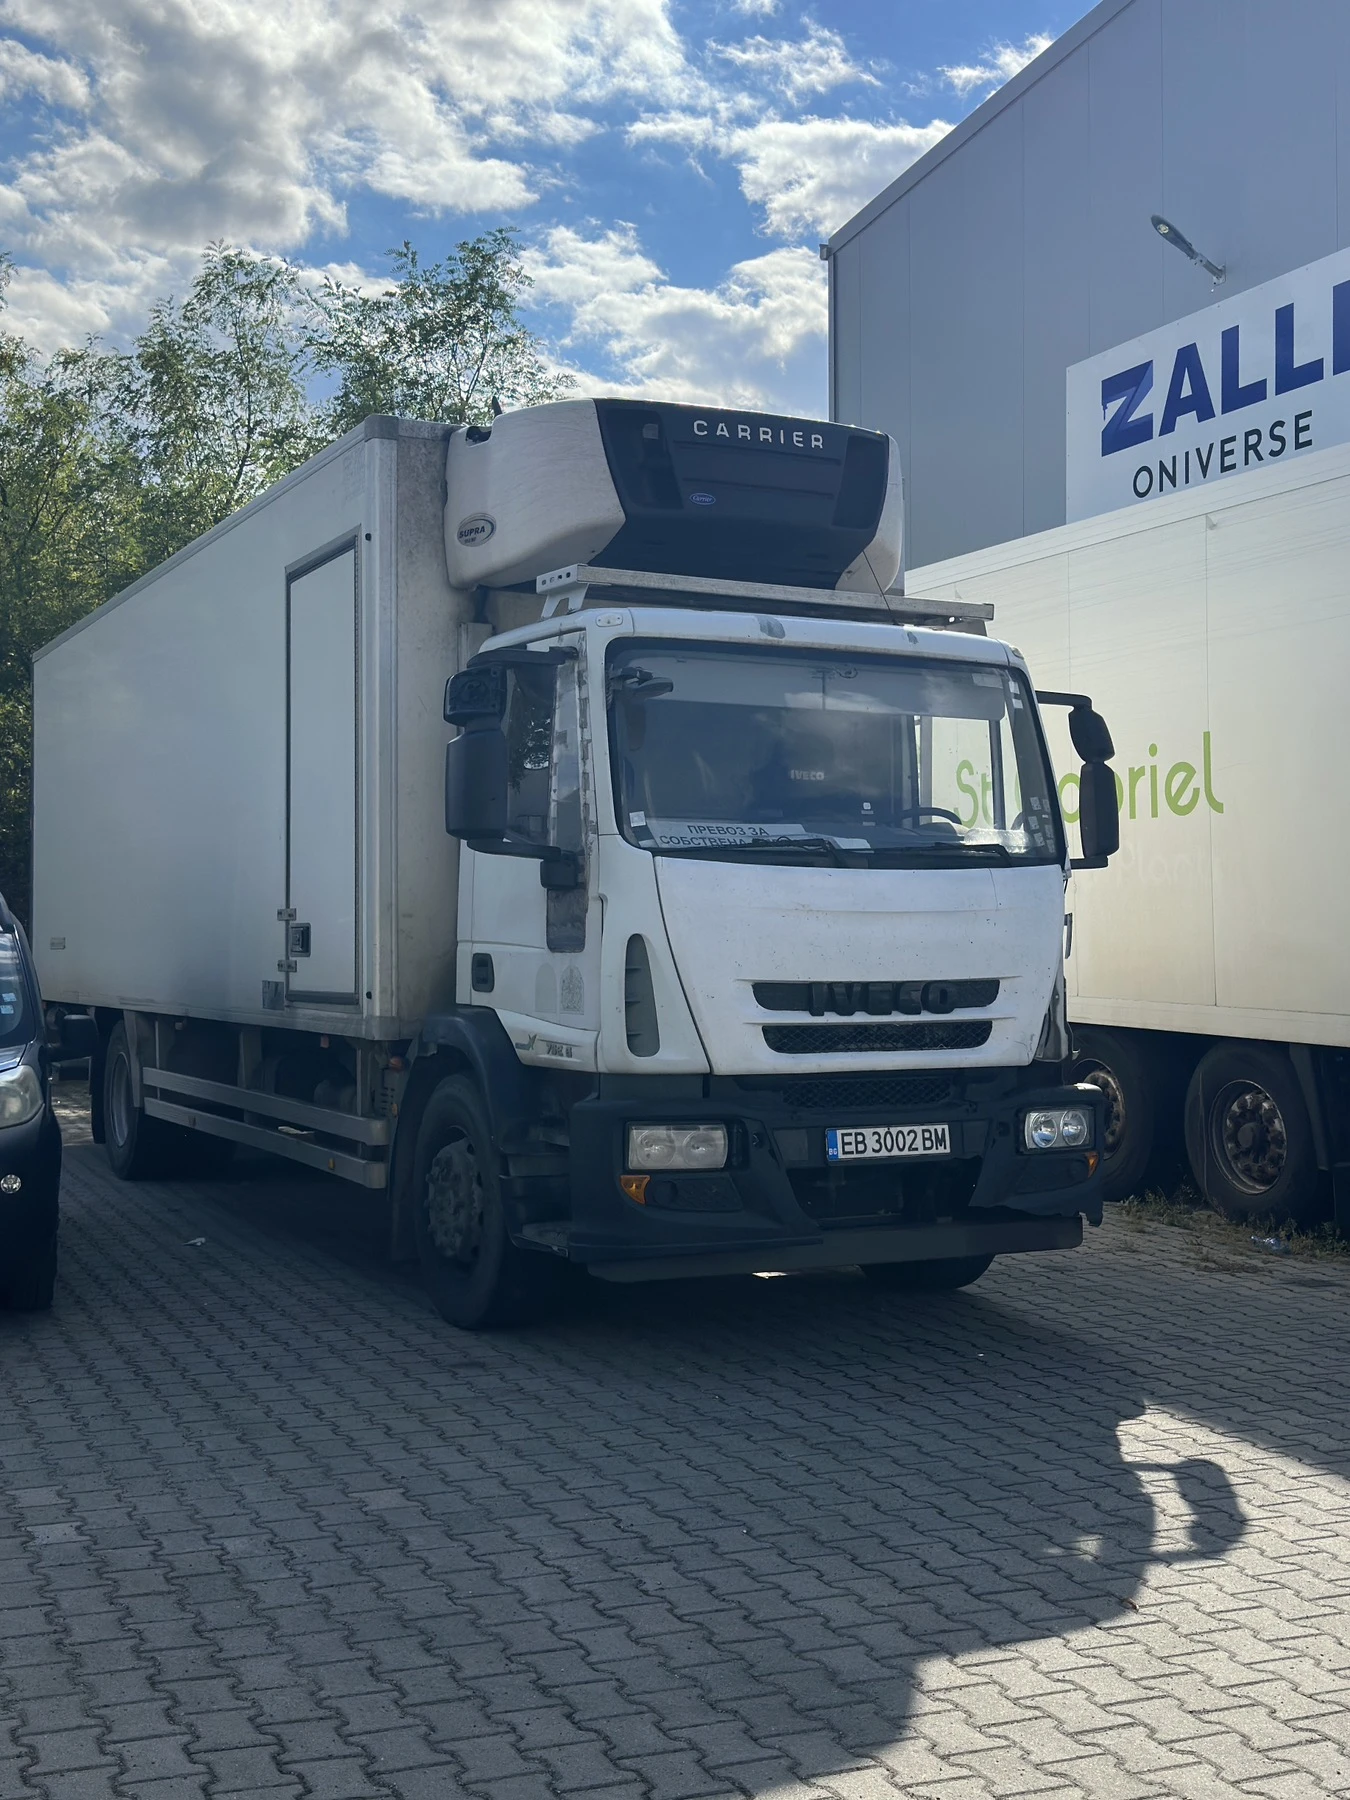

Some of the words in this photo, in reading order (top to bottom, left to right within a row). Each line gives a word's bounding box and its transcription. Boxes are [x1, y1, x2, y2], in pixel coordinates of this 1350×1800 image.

[693, 420, 823, 449] CARRIER
[1132, 410, 1313, 499] ONIVERSE
[692, 495, 713, 503] Carrier
[459, 526, 486, 539] SUPRA
[790, 770, 825, 780] IVECO
[686, 825, 746, 836] ПРЕВОЗ
[750, 827, 769, 836] ЗА
[810, 981, 956, 1017] IVECO
[828, 1148, 838, 1156] BG
